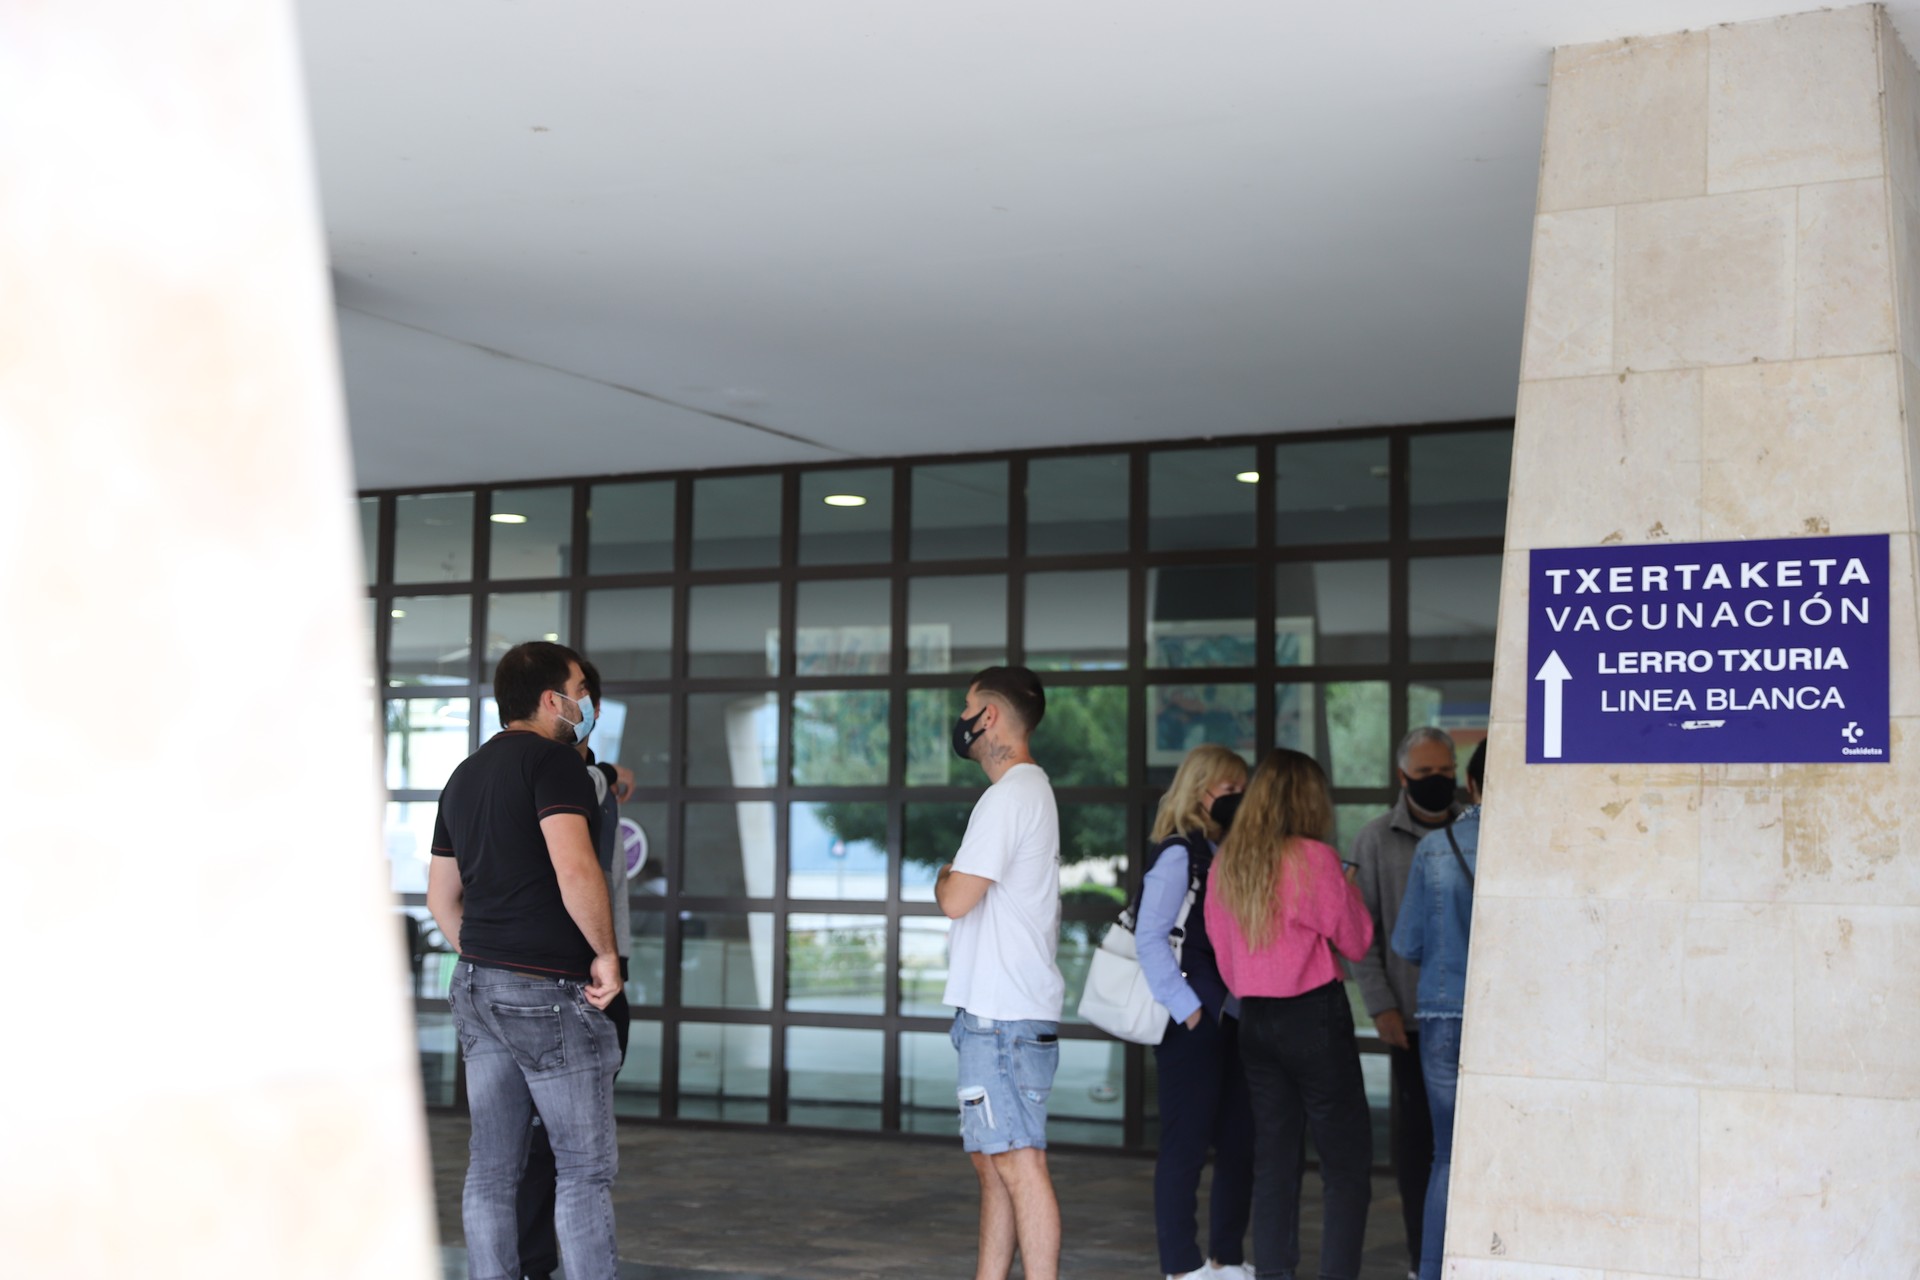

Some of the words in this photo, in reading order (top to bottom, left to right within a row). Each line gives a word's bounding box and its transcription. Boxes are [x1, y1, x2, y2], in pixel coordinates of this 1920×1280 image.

[1545, 557, 1871, 595] TXERTAKETA
[1545, 591, 1870, 632] VACUNACIÓN
[1598, 649, 1714, 674] LERRO
[1717, 646, 1849, 672] TXURIA
[1601, 688, 1697, 712] LINEA
[1706, 686, 1846, 711] BLANCA
